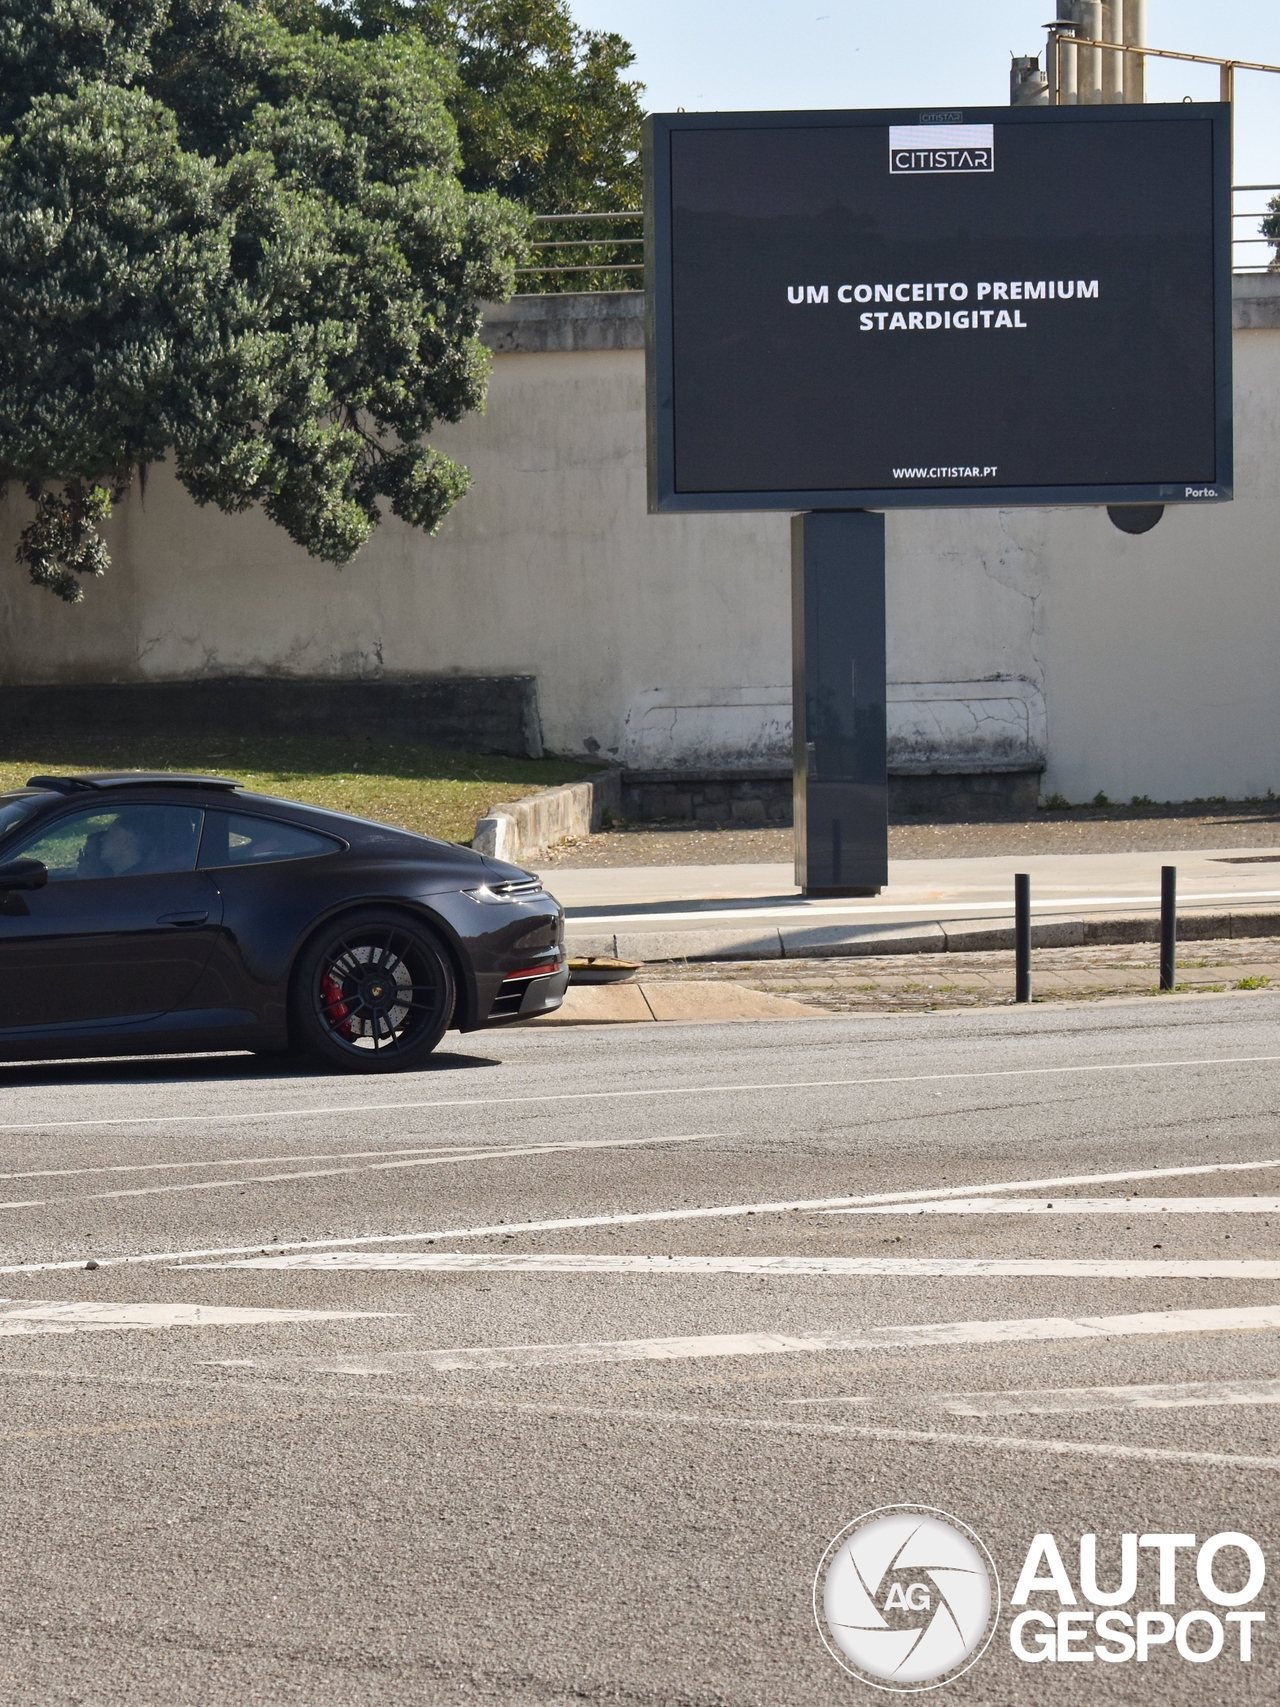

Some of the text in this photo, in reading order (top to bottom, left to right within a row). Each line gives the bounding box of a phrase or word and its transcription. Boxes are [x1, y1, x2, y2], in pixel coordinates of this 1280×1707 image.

[922, 113, 960, 122] CITISTAR
[895, 151, 988, 168] CITISTAR
[787, 279, 1100, 304] UM CONCEITO PREMIUM
[859, 309, 1028, 331] STARDIGITAL
[892, 466, 998, 479] WWW.CITISTAR.PT
[1185, 487, 1218, 498] Porto.
